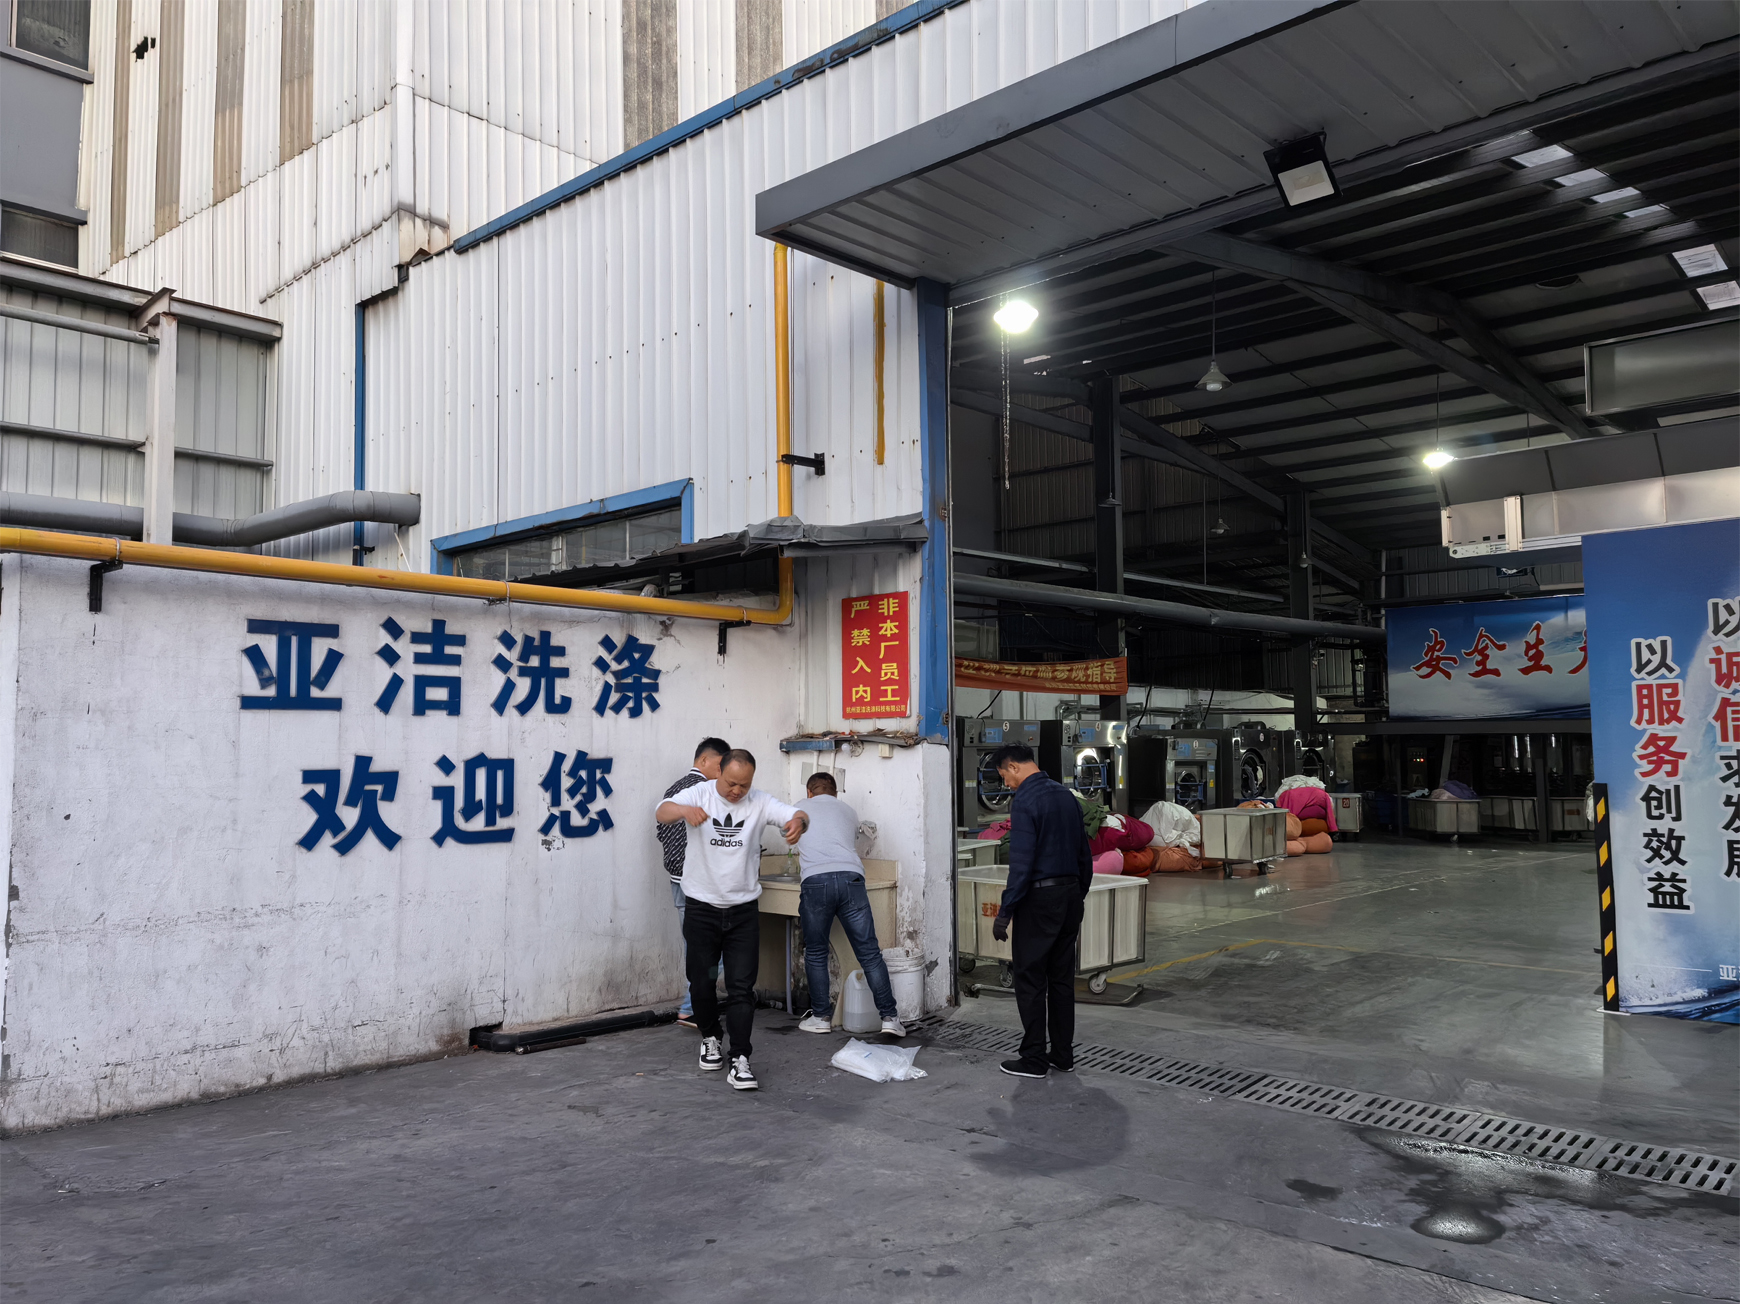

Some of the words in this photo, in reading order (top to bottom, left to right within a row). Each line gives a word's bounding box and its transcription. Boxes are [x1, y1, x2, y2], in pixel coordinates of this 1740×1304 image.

[240, 616, 662, 719] 亚洁洗涤
[850, 600, 872, 703] 严禁入内
[878, 597, 900, 702] 非本厂员工
[295, 750, 616, 857] 欢迎您
[1634, 638, 1691, 911] 以服务创效益
[710, 838, 743, 848] adidas
[1719, 964, 1740, 981] 亚
